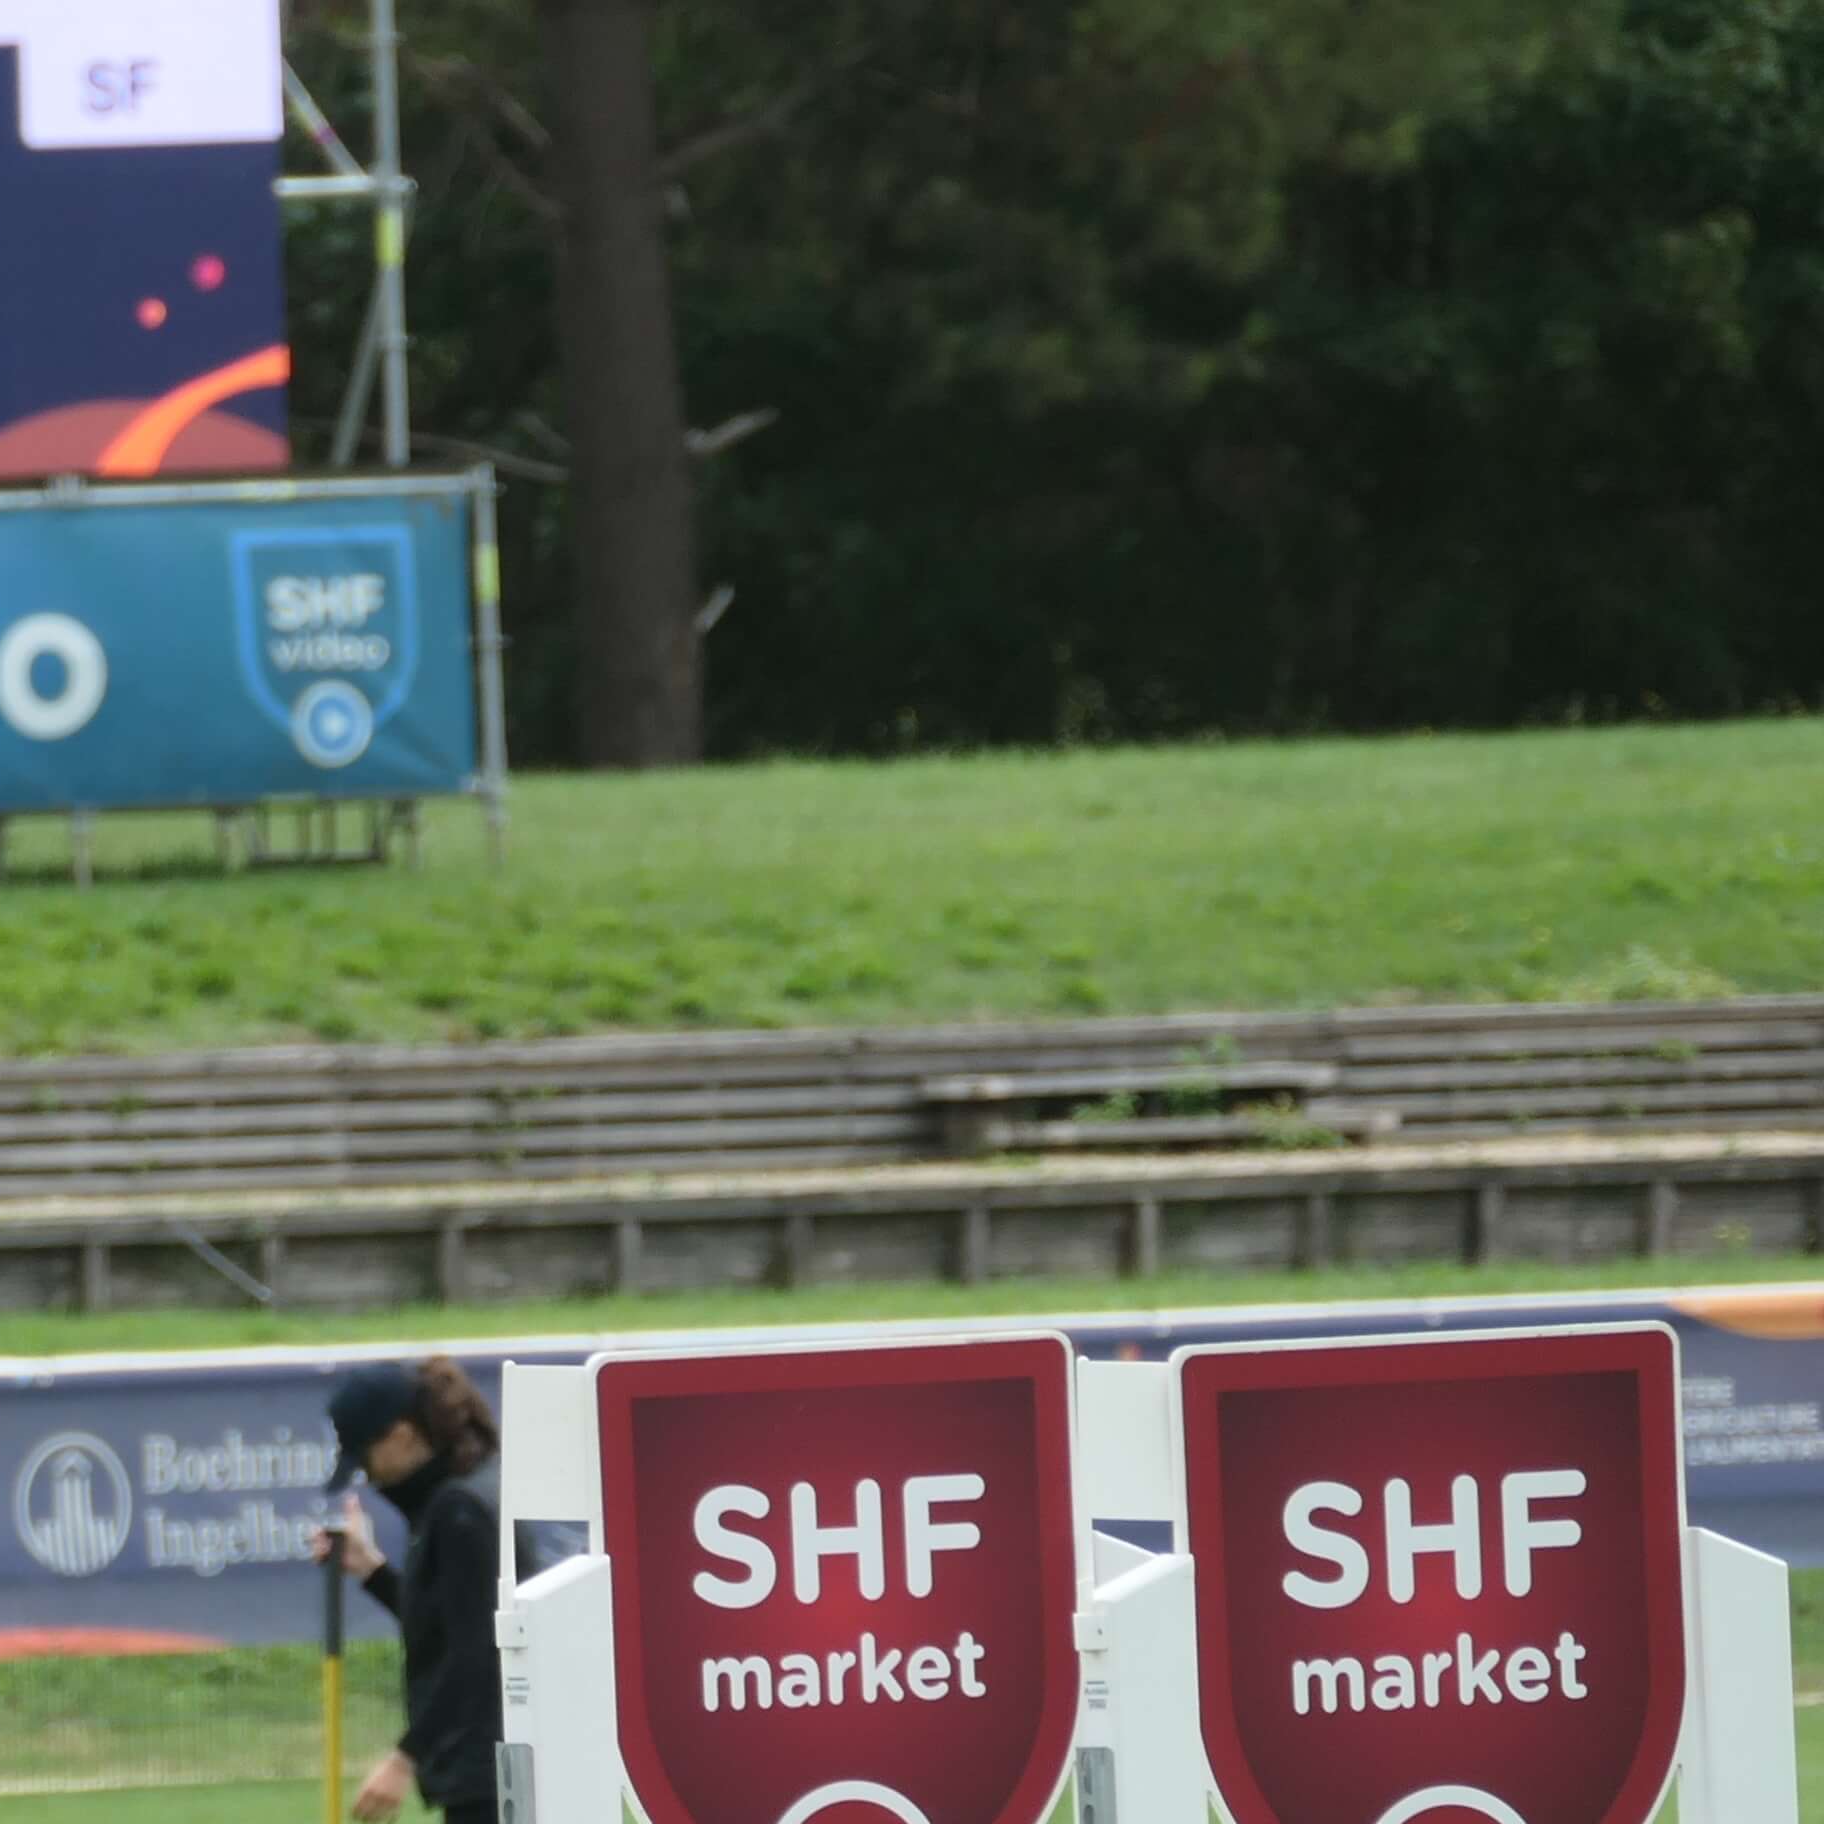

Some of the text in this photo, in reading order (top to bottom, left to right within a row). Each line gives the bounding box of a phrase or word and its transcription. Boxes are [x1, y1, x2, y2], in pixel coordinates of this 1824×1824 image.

[86, 60, 159, 113] SF
[265, 571, 386, 633] SHF
[266, 630, 392, 673] video
[144, 1497, 330, 1577] Ingelhe
[691, 1472, 986, 1609] SHF
[1281, 1468, 1587, 1610] SHF
[700, 1630, 987, 1713] market
[1290, 1630, 1588, 1716] market
